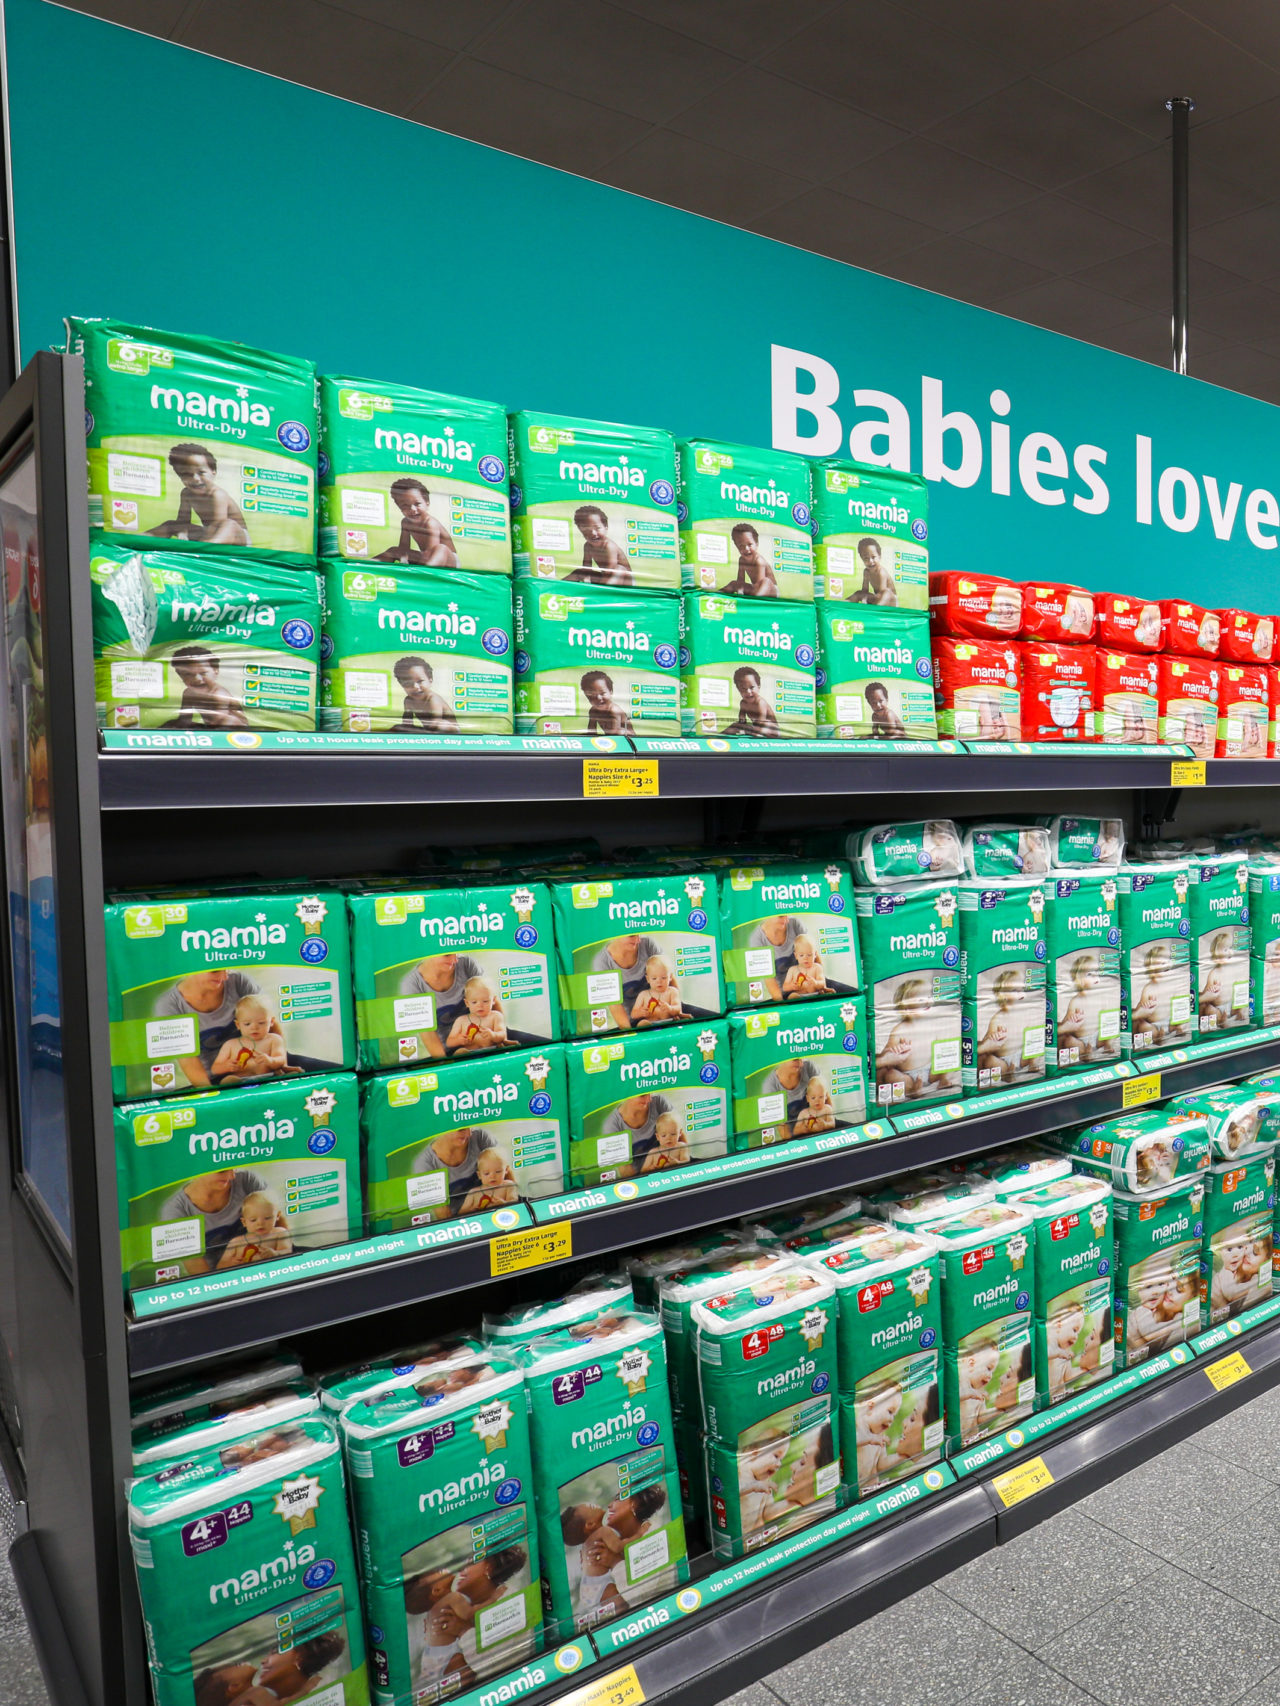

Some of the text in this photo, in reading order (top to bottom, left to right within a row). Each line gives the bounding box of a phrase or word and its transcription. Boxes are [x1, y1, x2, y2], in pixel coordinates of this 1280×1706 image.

[150, 386, 270, 427] mamia
[177, 416, 246, 439] Ultra-Dry
[771, 344, 1109, 515] Babies
[375, 427, 472, 462] mamia
[397, 454, 453, 473] Ultra-Dry
[559, 456, 644, 487] mamia
[578, 484, 628, 498] Ultra-Dry
[720, 479, 788, 508] mamia
[736, 503, 775, 518] Ultra-Dry
[848, 497, 908, 524] mamia
[862, 519, 896, 533] Ultra-Dry
[377, 577, 395, 587] 26
[172, 593, 276, 626] mamia
[1035, 599, 1062, 612] mamia
[378, 602, 476, 635] mamia
[188, 624, 252, 638] Ultra-Dry
[400, 633, 456, 648] Ultra-Dry
[568, 621, 649, 650] mamia
[723, 622, 791, 650] mamia
[586, 650, 633, 663] Ultra-Dry
[738, 647, 778, 660] Ultra-Dry
[854, 639, 912, 664] mamia
[867, 664, 901, 674] Ultra-Dry
[971, 663, 1006, 678] mamia
[1119, 673, 1148, 688] mamia
[127, 731, 212, 746] mamia
[277, 736, 294, 745] Up
[444, 738, 461, 746] day
[522, 737, 582, 749] mamia
[632, 777, 653, 787] £3.25
[761, 874, 820, 901] mamia
[609, 889, 679, 920] mamia
[775, 900, 809, 910] Ultra-Dry
[1142, 900, 1181, 922] mamia
[136, 907, 186, 926] 6 30
[420, 903, 503, 937] mamia
[625, 918, 666, 928] Ultra-Dry
[1068, 907, 1111, 931] mamia
[181, 913, 286, 952] mamia
[439, 935, 487, 947] Ultra-Dry
[890, 923, 946, 951] mamia
[992, 919, 1038, 944] mamia
[205, 949, 266, 962] Ultra-Dry
[776, 1015, 835, 1046] mamia
[790, 1042, 824, 1054] Ultra-Dry
[620, 1046, 690, 1082] mamia
[636, 1076, 677, 1088] Ultra-Dry
[434, 1074, 518, 1115] mamia
[144, 1111, 194, 1133] 6 30
[453, 1107, 502, 1122] Ultra-Dry
[189, 1109, 294, 1155] mamia
[815, 1130, 859, 1150] mamia
[213, 1146, 274, 1163] Ultra-Dry
[549, 1190, 606, 1215] mamia
[417, 1219, 482, 1247] mamia
[1152, 1213, 1189, 1241] mamia
[496, 1242, 511, 1250] Ultra
[541, 1231, 558, 1239] Large
[543, 1239, 566, 1253] £3.29
[497, 1247, 521, 1257] Nappies
[1060, 1242, 1101, 1271] mamia
[149, 1240, 405, 1305] Up to 12 hours leak protection day and night
[1069, 1262, 1093, 1275] Ultra-Dry
[863, 1281, 893, 1302] 4 48
[973, 1275, 1018, 1306] mamia
[983, 1295, 1010, 1310] Ultra-Dry
[748, 1326, 783, 1348] 4 48
[871, 1311, 923, 1347] mamia
[882, 1333, 913, 1350] Ultra-Dry
[558, 1365, 600, 1393] 4+ 44
[757, 1356, 816, 1395] mamia
[770, 1380, 804, 1398] Ultra-Dry
[572, 1401, 645, 1449] mamia
[589, 1430, 633, 1452] Ultra-Dry
[963, 1442, 1003, 1470] mamia
[281, 1484, 310, 1500] Mother
[419, 1458, 505, 1512] mamia
[288, 1492, 309, 1504] Baby
[439, 1489, 489, 1515] Ultra-Dry
[876, 1484, 920, 1514] mamia
[190, 1503, 250, 1541] 4+ 44
[710, 1509, 871, 1593] Up to 12 hours leak protection day and night
[210, 1541, 315, 1604] mamia
[235, 1573, 296, 1606] Ultra-Dry
[611, 1606, 670, 1646] mamia
[479, 1666, 546, 1706] mamia
[606, 1675, 631, 1693] Nappies
[610, 1687, 634, 1705] £3.49
